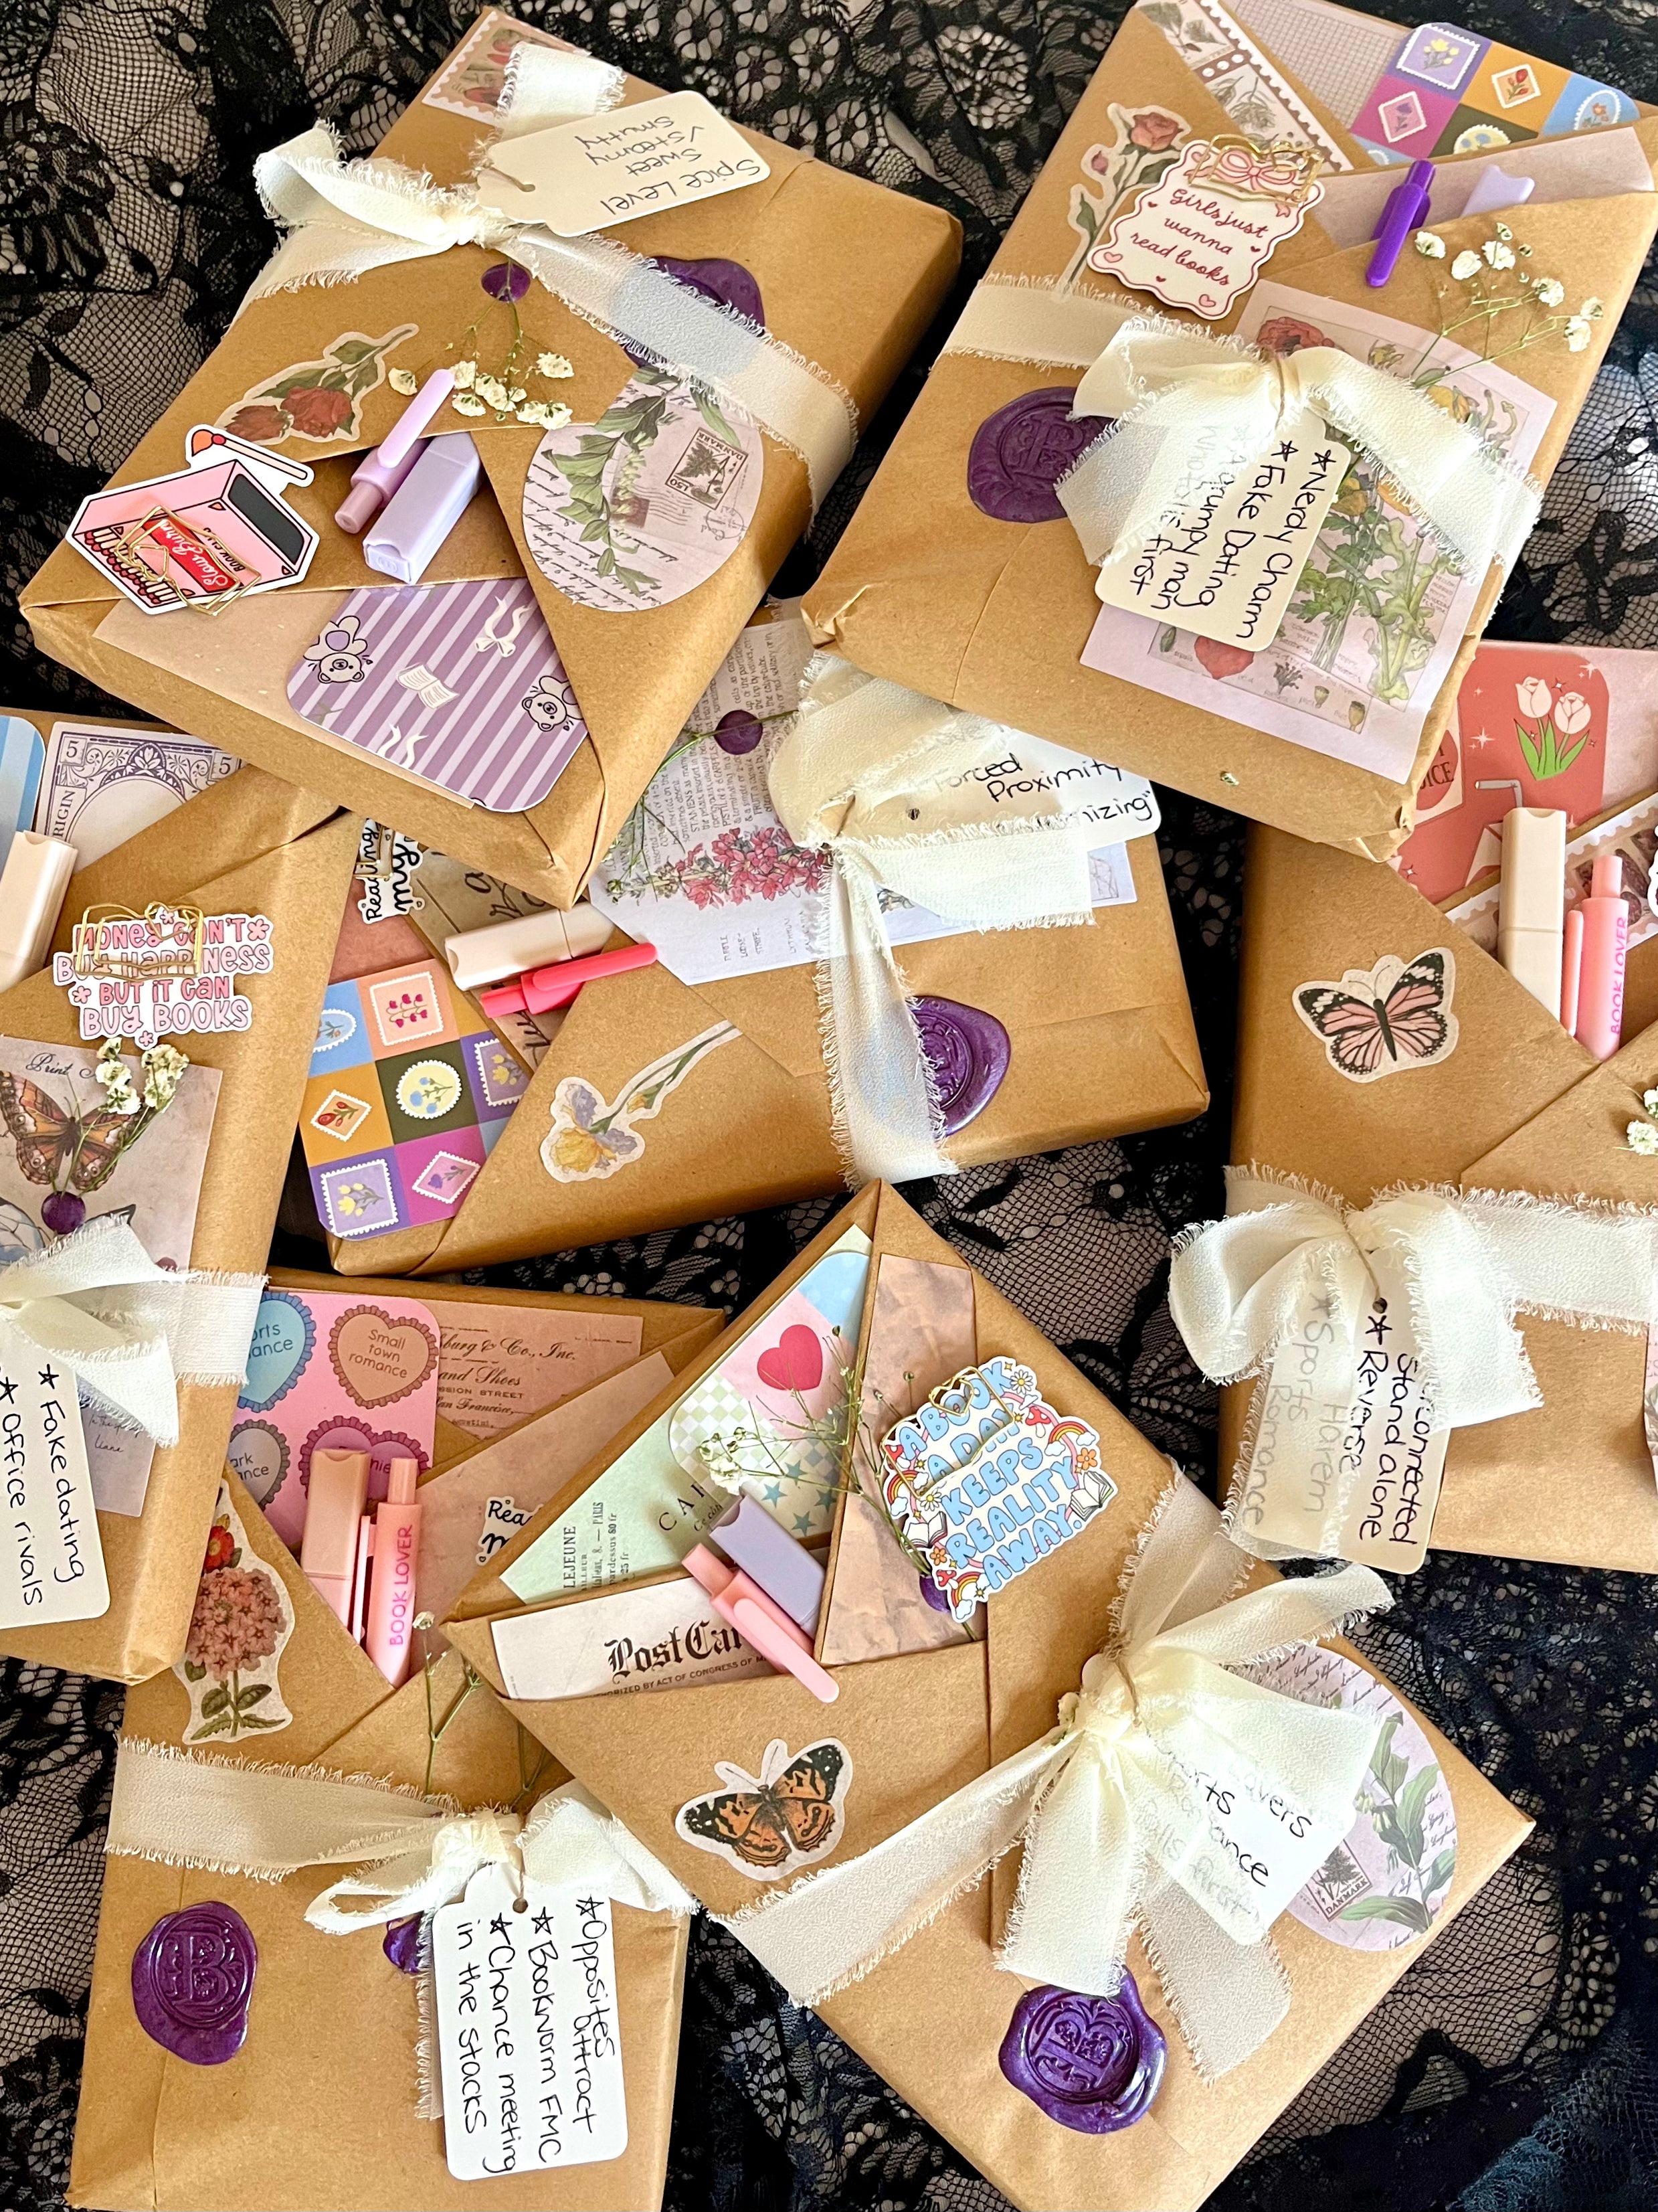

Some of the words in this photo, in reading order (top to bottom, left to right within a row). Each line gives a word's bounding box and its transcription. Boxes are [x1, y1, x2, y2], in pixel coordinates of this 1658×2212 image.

[680, 159, 760, 188] Spice
[600, 181, 677, 214] Level
[1131, 233, 1178, 257] read
[1176, 250, 1228, 285] books
[1165, 218, 1232, 254] wanna
[699, 432, 743, 460] DANMARK
[1237, 464, 1285, 519] Fake
[1263, 472, 1327, 543] Nerdy
[189, 554, 228, 586] Slow
[1130, 535, 1173, 595] first
[1151, 562, 1189, 610] man
[1173, 530, 1256, 606] Dating
[1236, 553, 1292, 638] Charm
[66, 740, 80, 758] 5
[219, 757, 232, 775] 5
[987, 758, 1121, 802] Proximity
[1419, 762, 1454, 790] ICE
[53, 790, 76, 837] RIGIN
[684, 790, 700, 831] STAMENS
[1613, 916, 1627, 976] LOVER
[153, 999, 248, 1033] BOOKS
[1610, 983, 1623, 1035] BOOK
[25, 1052, 74, 1076] Print
[248, 1339, 293, 1359] ance
[369, 1329, 405, 1350] Small
[369, 1343, 400, 1363] town
[349, 1352, 407, 1379] romance
[440, 1367, 472, 1381] and
[438, 1386, 472, 1395] SSION
[899, 1426, 928, 1461] A
[920, 1361, 1013, 1442] BOOK
[40, 1400, 67, 1474] Fake
[941, 1437, 1044, 1526] KEEPS
[945, 1456, 1079, 1569] REALITY
[15, 1521, 43, 1606] rivals
[394, 1524, 413, 1586] LOVER
[563, 1526, 576, 1589] LEJEUNE
[389, 1590, 407, 1646] BOOK
[604, 1625, 683, 1685] Post
[684, 1619, 743, 1660] Car
[656, 1676, 673, 1687] ACT
[675, 1673, 688, 1683] OF
[1325, 1877, 1368, 1916] DANMARK
[456, 1919, 481, 1950] in
[459, 1962, 481, 2015] the
[488, 1946, 515, 2059] Chance
[571, 1920, 615, 2058] Opposites
